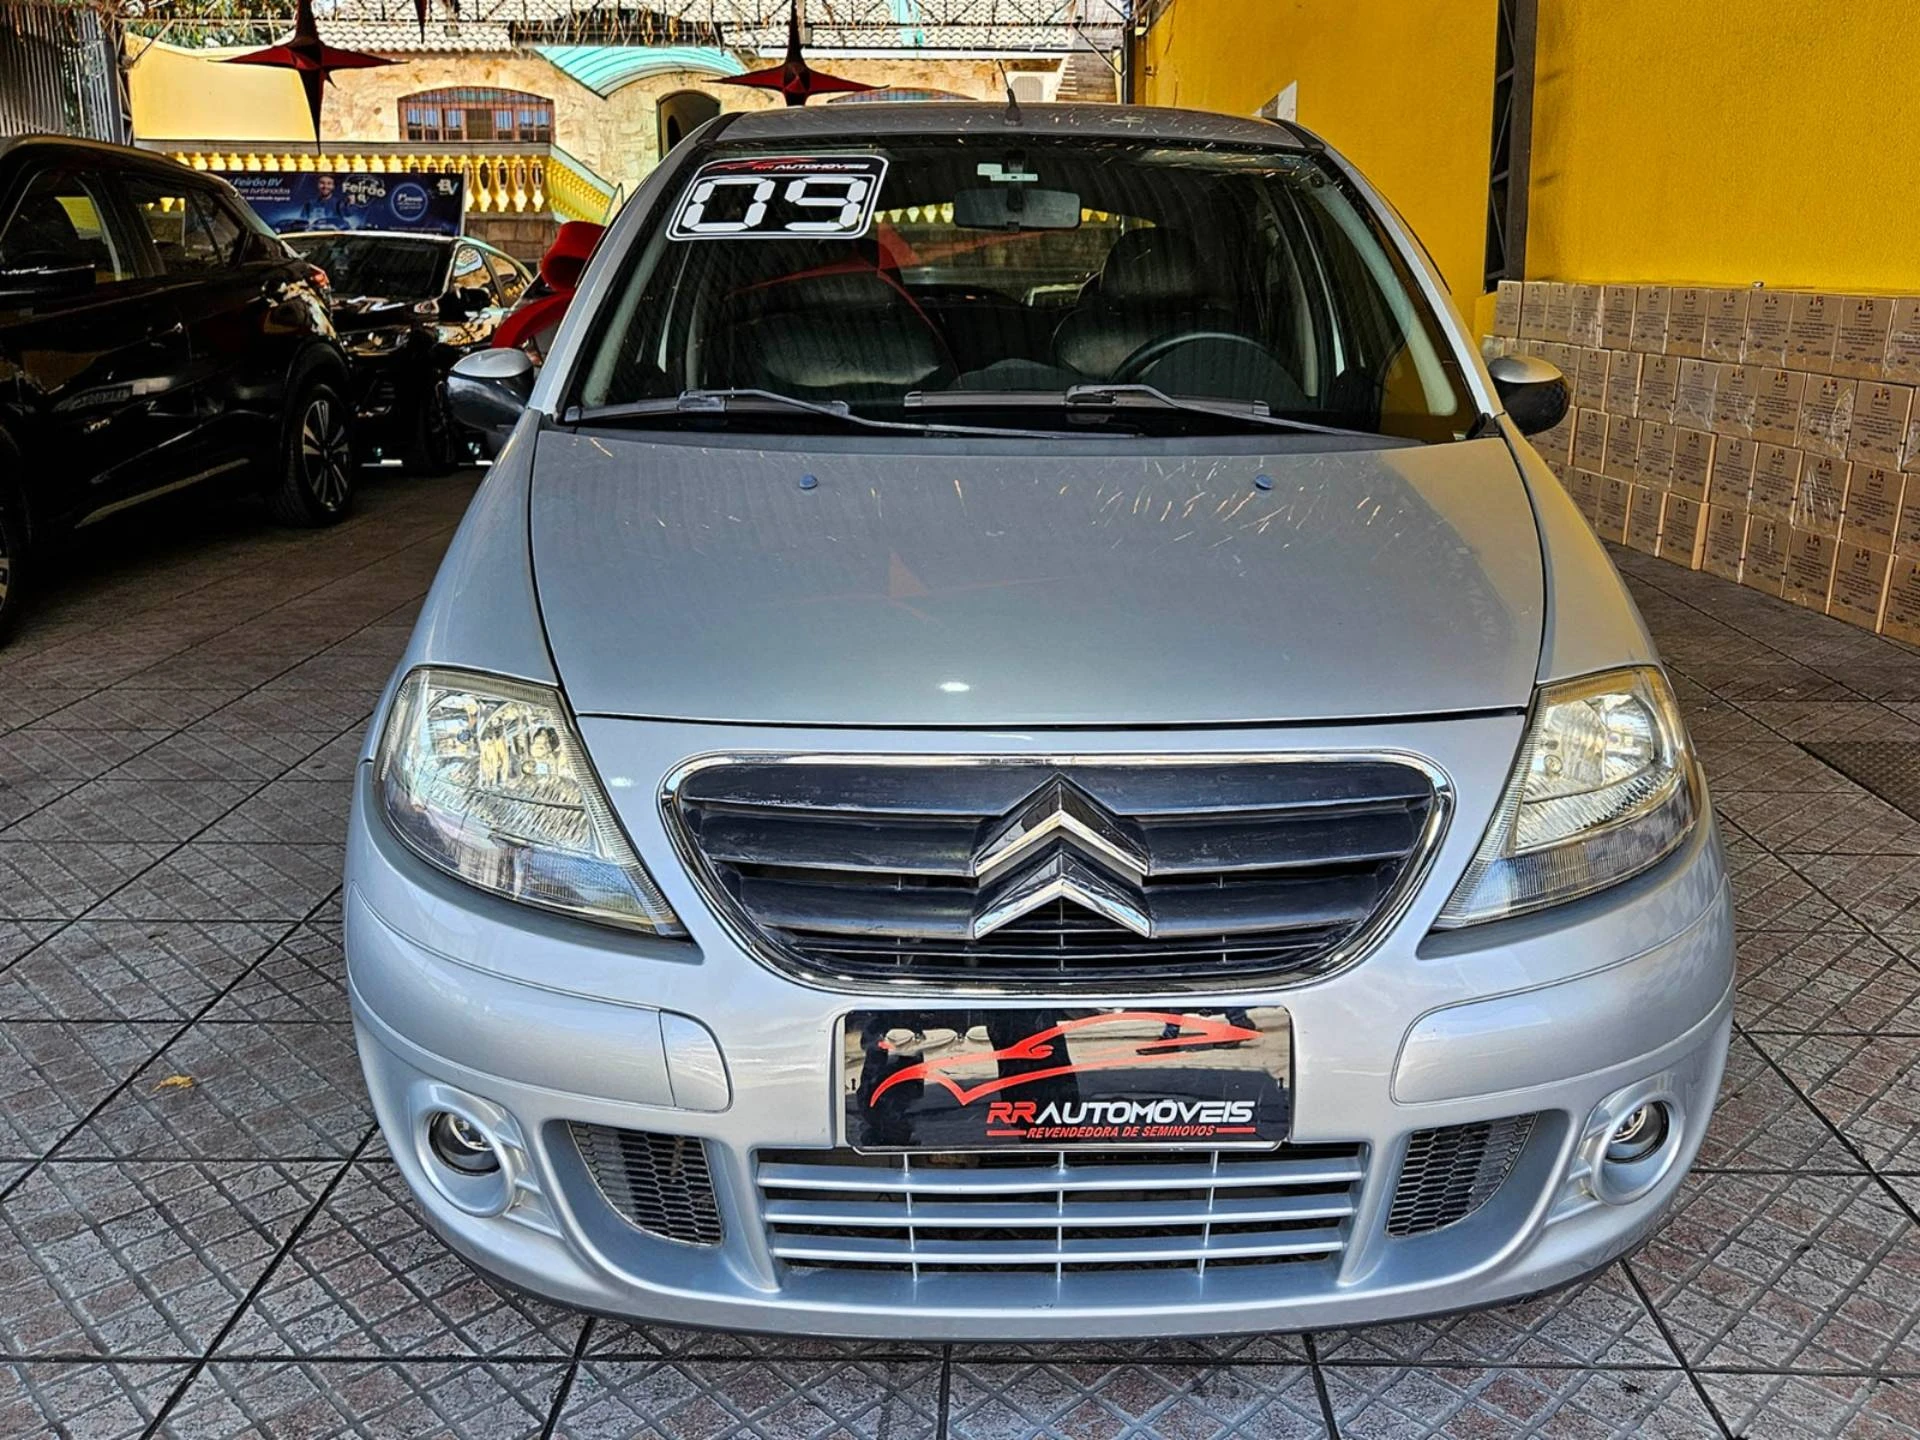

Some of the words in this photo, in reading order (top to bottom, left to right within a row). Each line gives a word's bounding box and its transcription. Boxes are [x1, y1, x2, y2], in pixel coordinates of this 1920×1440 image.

[342, 180, 386, 198] Feirão
[681, 176, 868, 232] 09
[1026, 1126, 1118, 1139] REVENDEDORA
[1122, 1125, 1140, 1137] DE
[1141, 1124, 1217, 1137] SEMINOVOS
